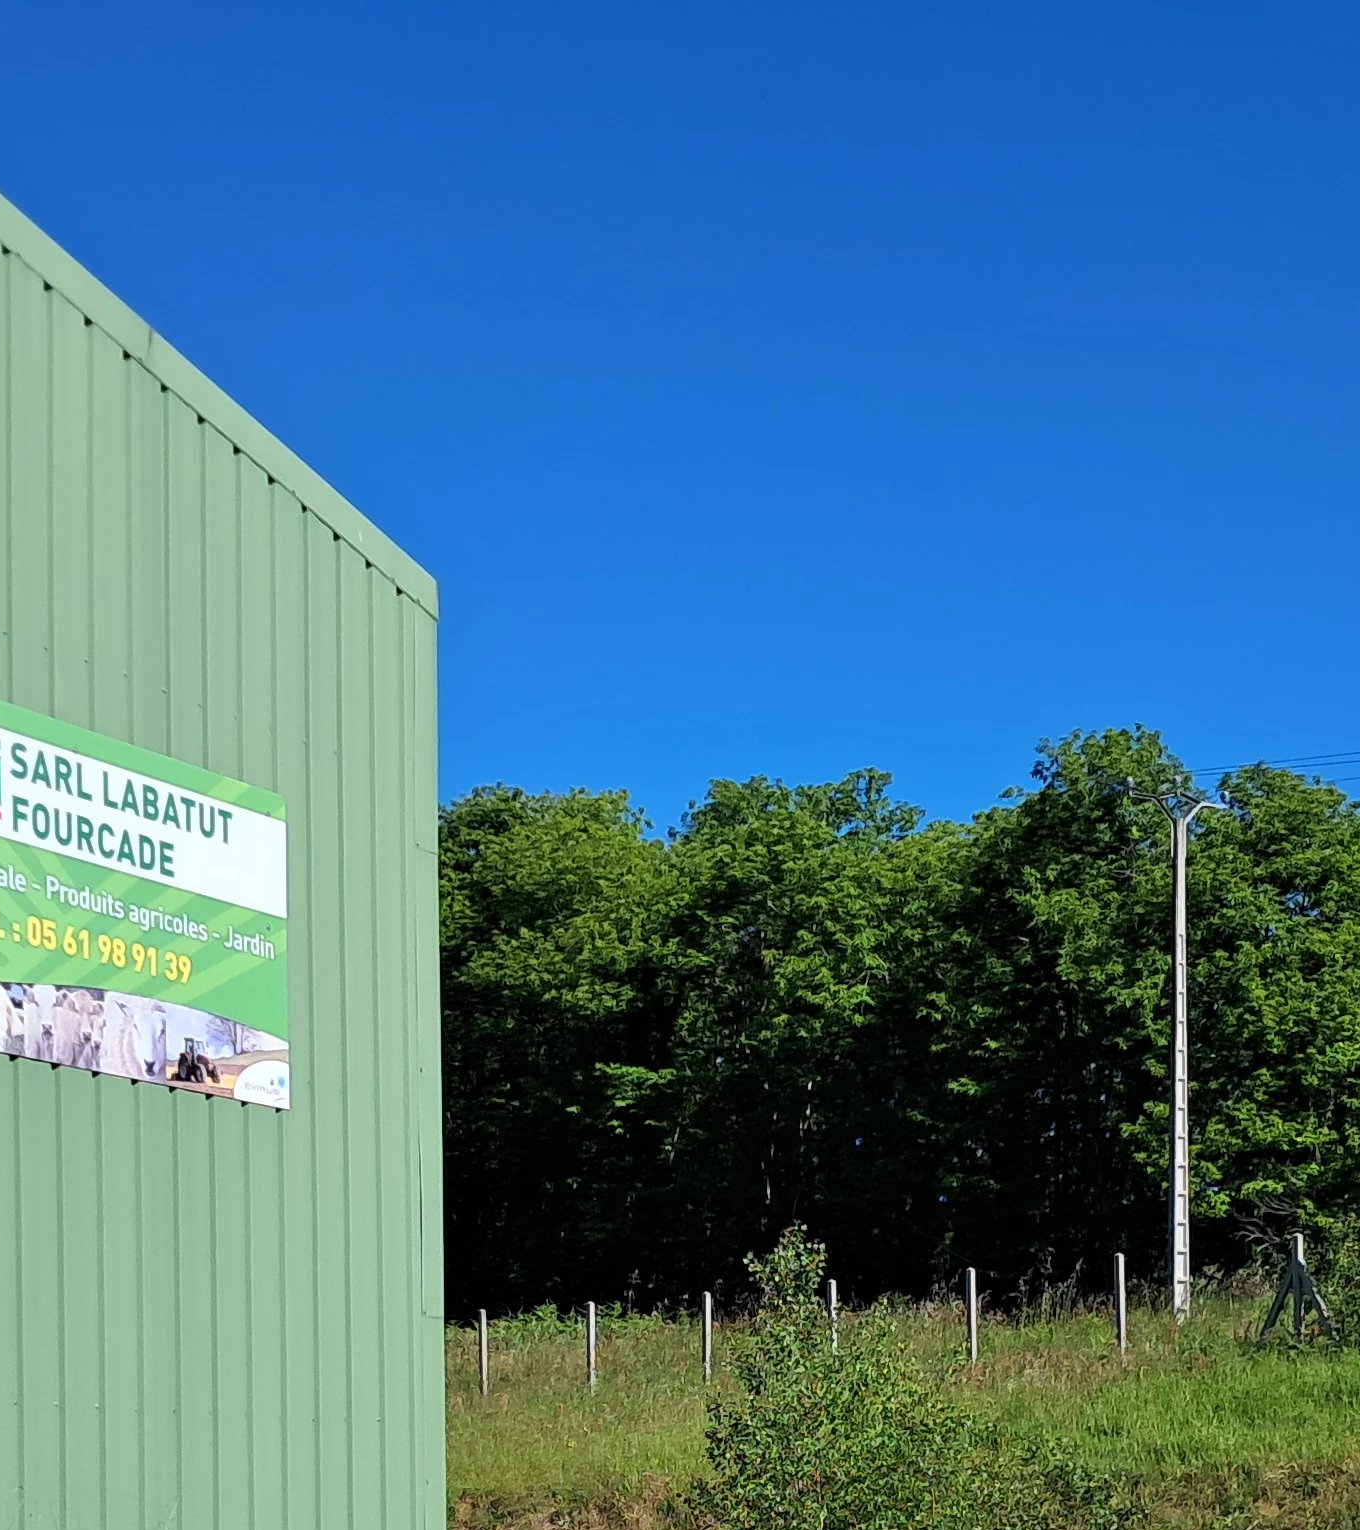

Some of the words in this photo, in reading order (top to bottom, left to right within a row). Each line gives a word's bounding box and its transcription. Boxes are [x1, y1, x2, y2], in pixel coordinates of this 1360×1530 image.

[10, 742, 92, 802] SARL
[103, 770, 234, 844] LABATUT
[12, 795, 176, 878] FOURCADE
[26, 915, 57, 951] 05
[63, 924, 90, 960] 61
[98, 934, 127, 968] 98
[131, 943, 158, 977] 91
[164, 951, 193, 985] 39
[45, 874, 125, 919] Produits
[128, 906, 209, 942] agricoles
[224, 925, 276, 961] Jardin
